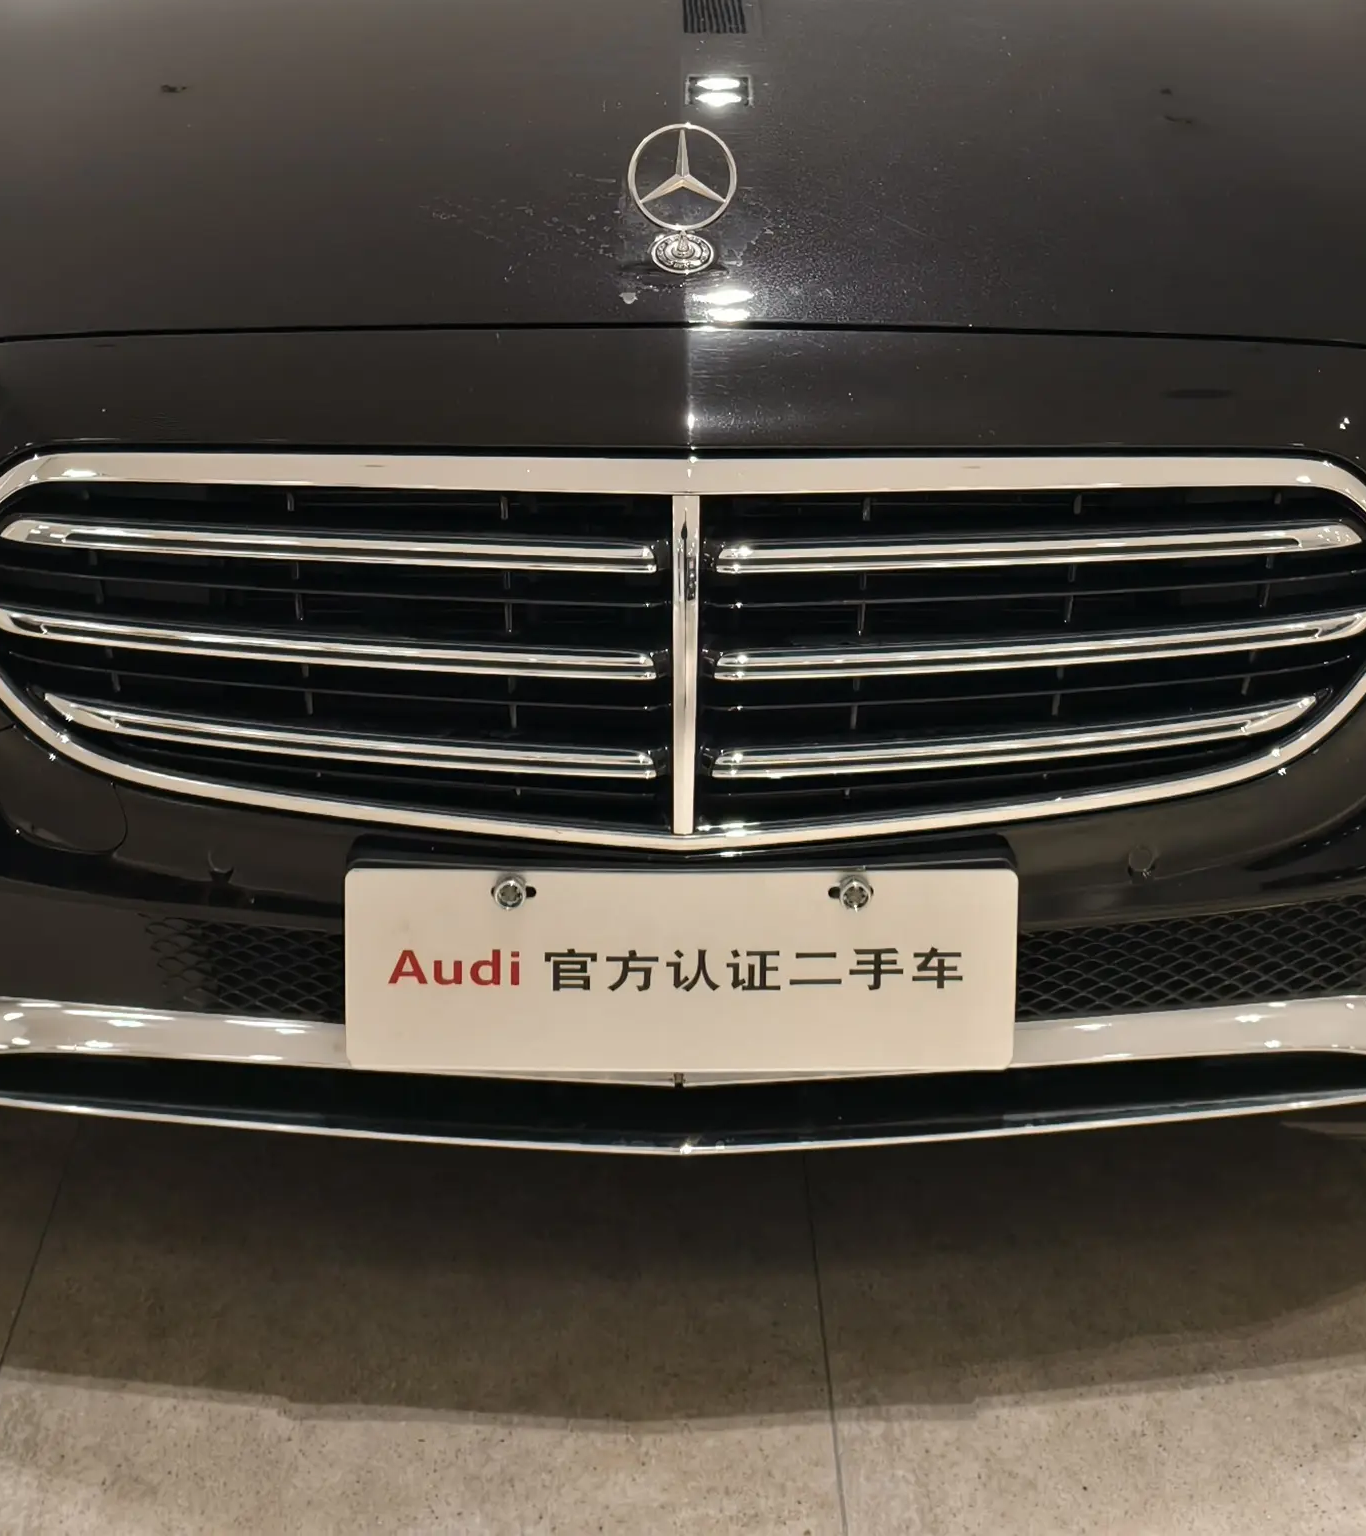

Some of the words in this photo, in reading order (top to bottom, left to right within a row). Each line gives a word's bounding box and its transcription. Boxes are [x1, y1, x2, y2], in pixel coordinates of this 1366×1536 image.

[387, 948, 521, 986] Audi
[544, 947, 965, 993] 官方认证二手车
